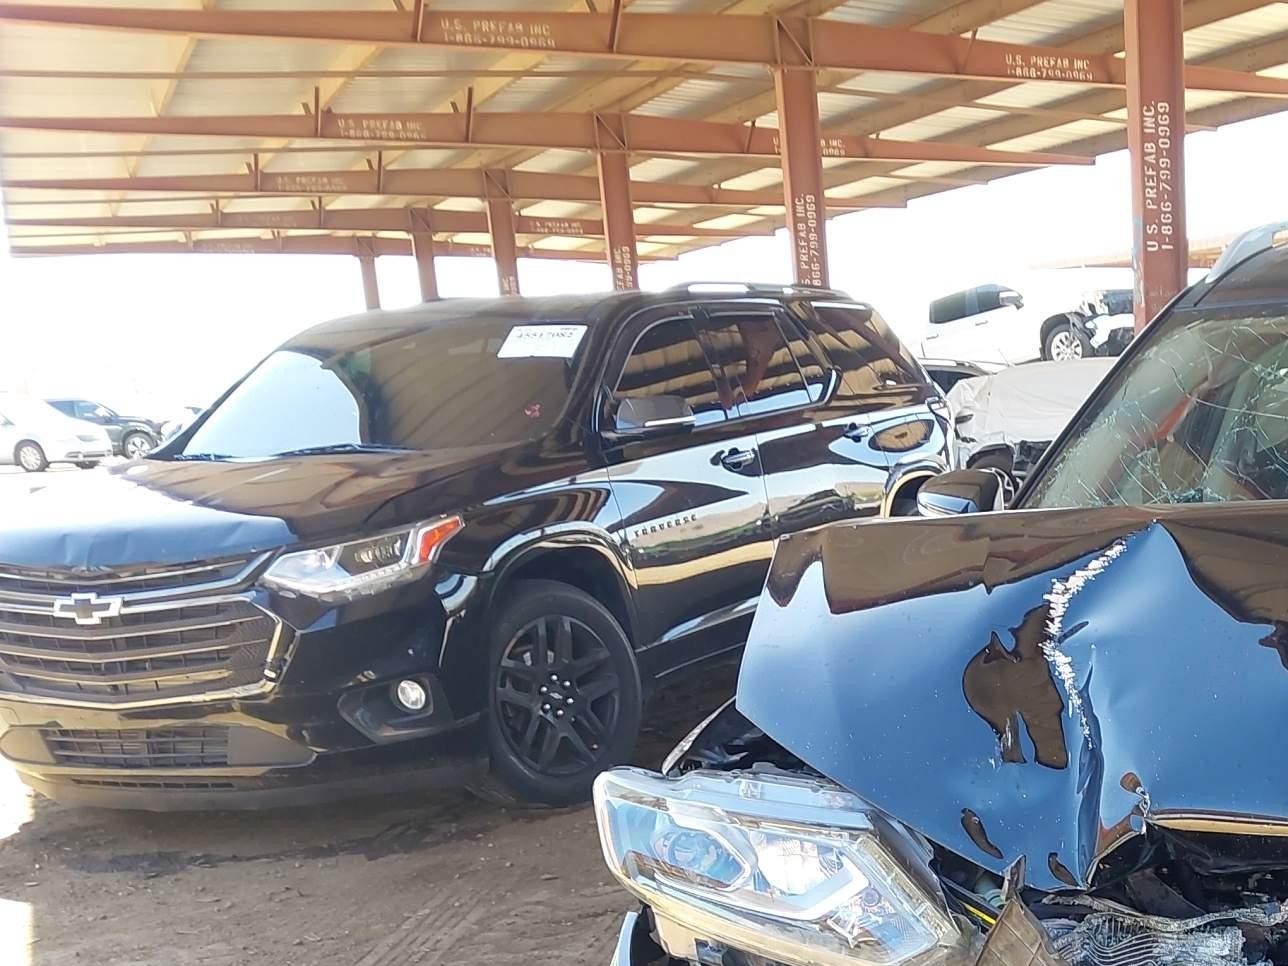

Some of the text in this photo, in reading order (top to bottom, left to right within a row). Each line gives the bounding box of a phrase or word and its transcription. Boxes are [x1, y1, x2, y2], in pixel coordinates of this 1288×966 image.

[1142, 100, 1156, 133] INC.
[1144, 142, 1158, 209] PREFAB
[1157, 102, 1174, 249] 1-866-799-0969
[797, 222, 811, 269] PREFAB
